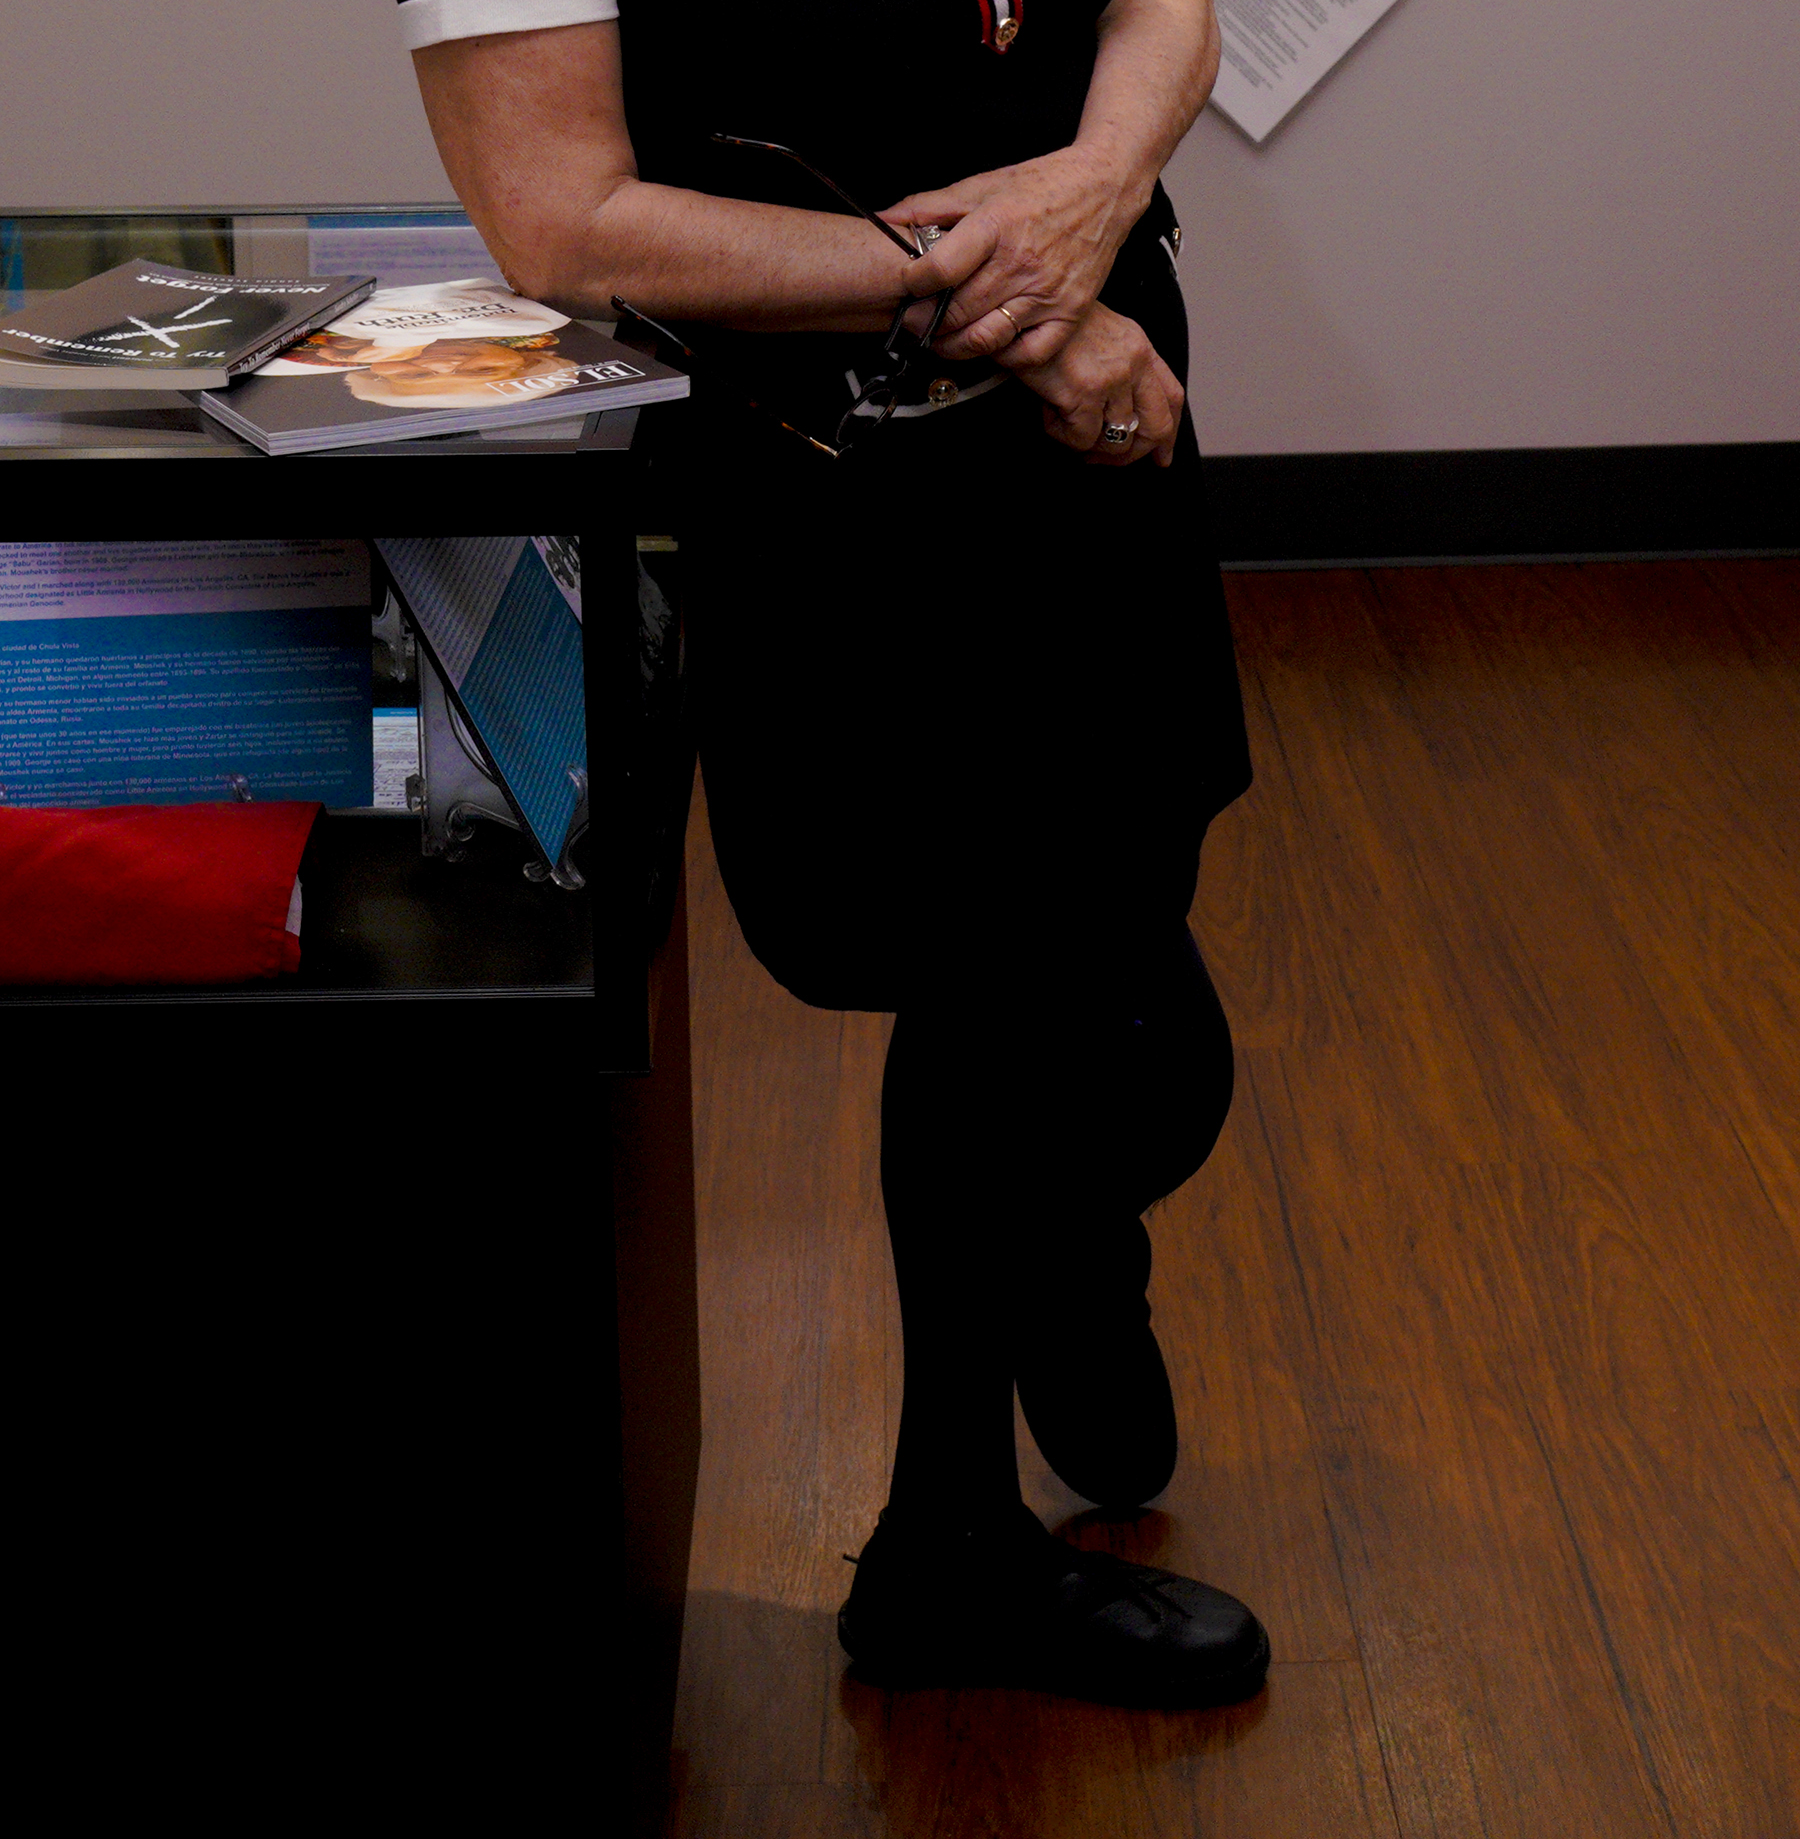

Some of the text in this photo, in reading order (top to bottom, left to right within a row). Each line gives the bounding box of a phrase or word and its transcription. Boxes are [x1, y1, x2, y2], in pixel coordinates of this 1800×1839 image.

[134, 274, 234, 295] Forget
[238, 286, 328, 295] Never
[353, 311, 446, 328] Ruth
[0, 327, 227, 360] Try To Remember
